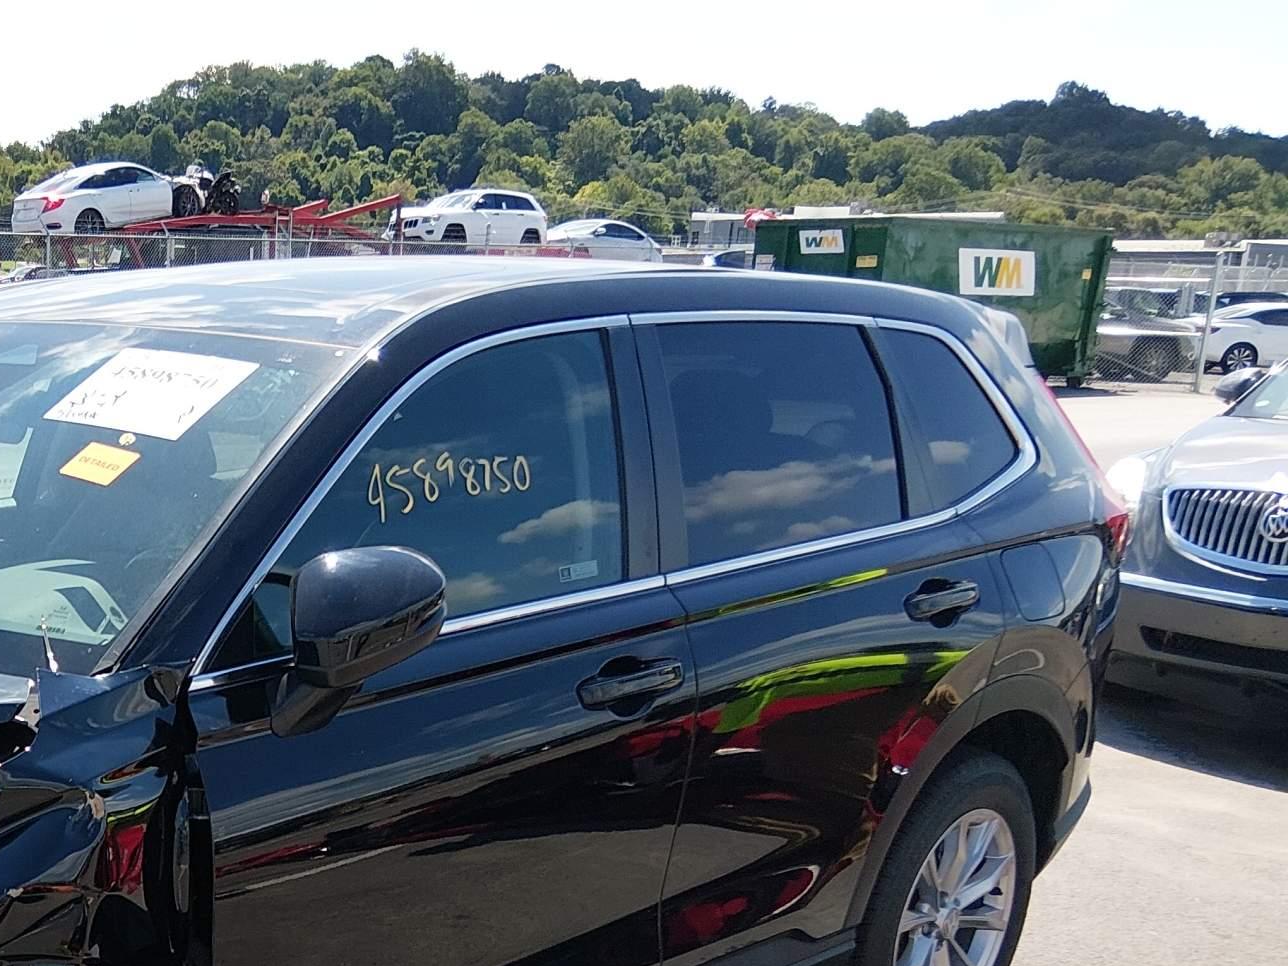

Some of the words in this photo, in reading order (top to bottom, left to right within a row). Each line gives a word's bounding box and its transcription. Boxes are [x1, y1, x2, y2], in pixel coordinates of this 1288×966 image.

[805, 236, 839, 249] WM
[973, 255, 1023, 289] WM
[367, 451, 531, 524] 45898750
